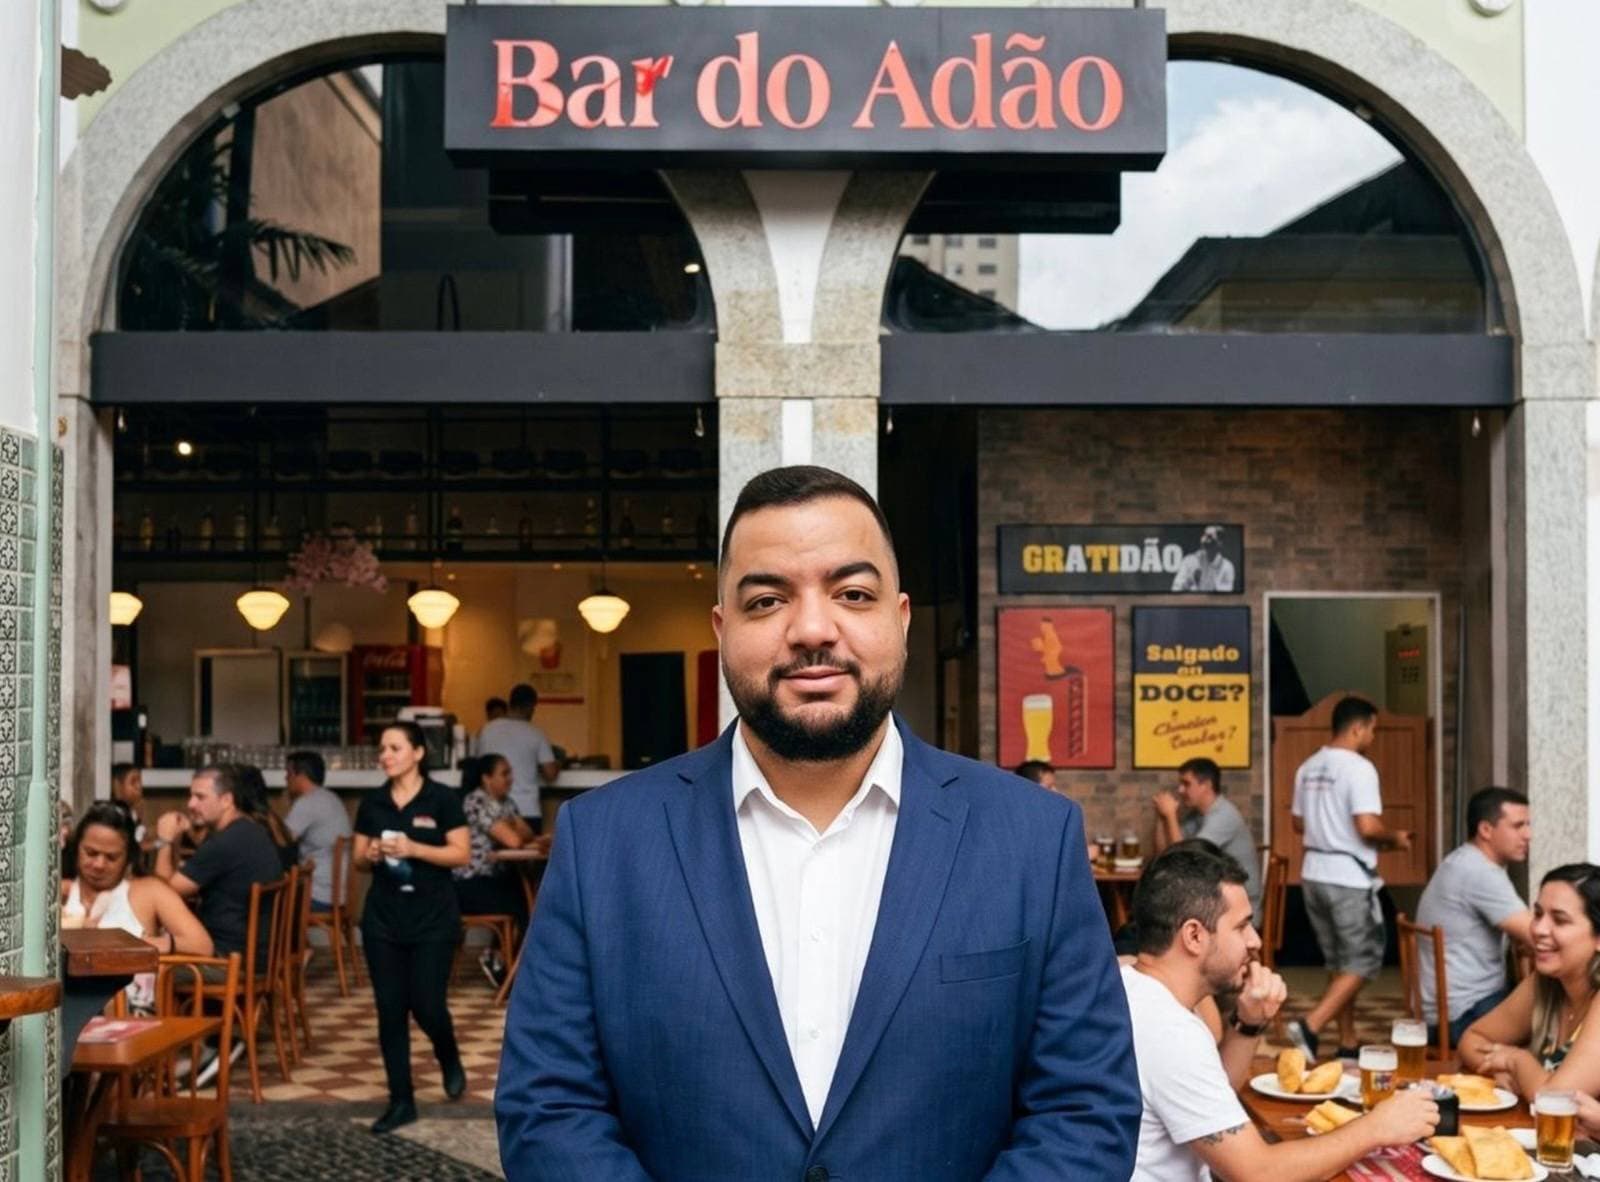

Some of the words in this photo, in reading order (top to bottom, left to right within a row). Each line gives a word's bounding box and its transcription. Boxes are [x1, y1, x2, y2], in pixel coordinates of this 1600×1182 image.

[490, 38, 674, 129] Bar
[696, 31, 831, 130] do
[851, 32, 1123, 131] Adão
[1022, 537, 1184, 573] GRATIDÃO
[1145, 644, 1240, 665] Salgado
[1140, 683, 1245, 702] DOCE?
